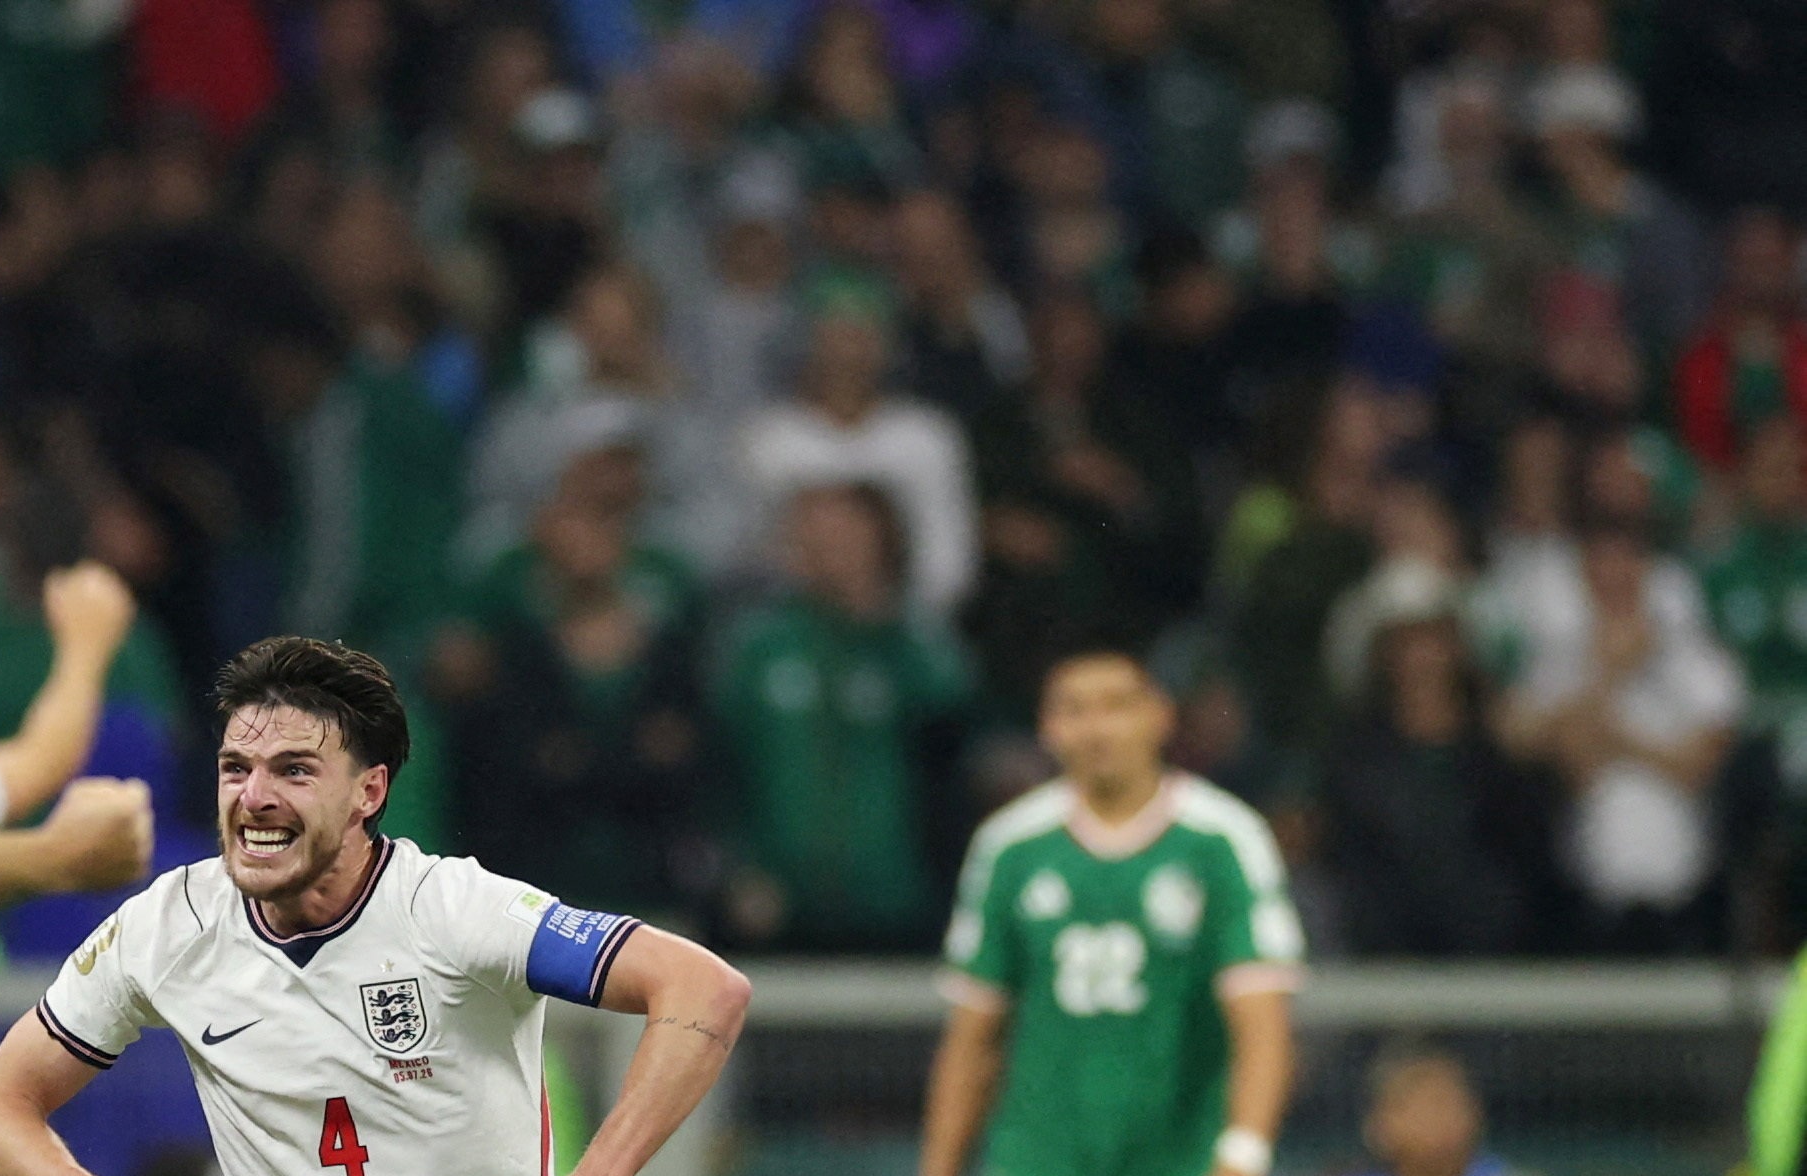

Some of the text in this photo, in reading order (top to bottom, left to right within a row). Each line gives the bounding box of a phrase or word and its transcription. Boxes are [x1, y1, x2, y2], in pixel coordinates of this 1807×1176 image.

[546, 904, 573, 931] FOOT
[558, 909, 593, 939] UNITE
[1051, 920, 1150, 1016] 22
[388, 1056, 430, 1070] MEXICO
